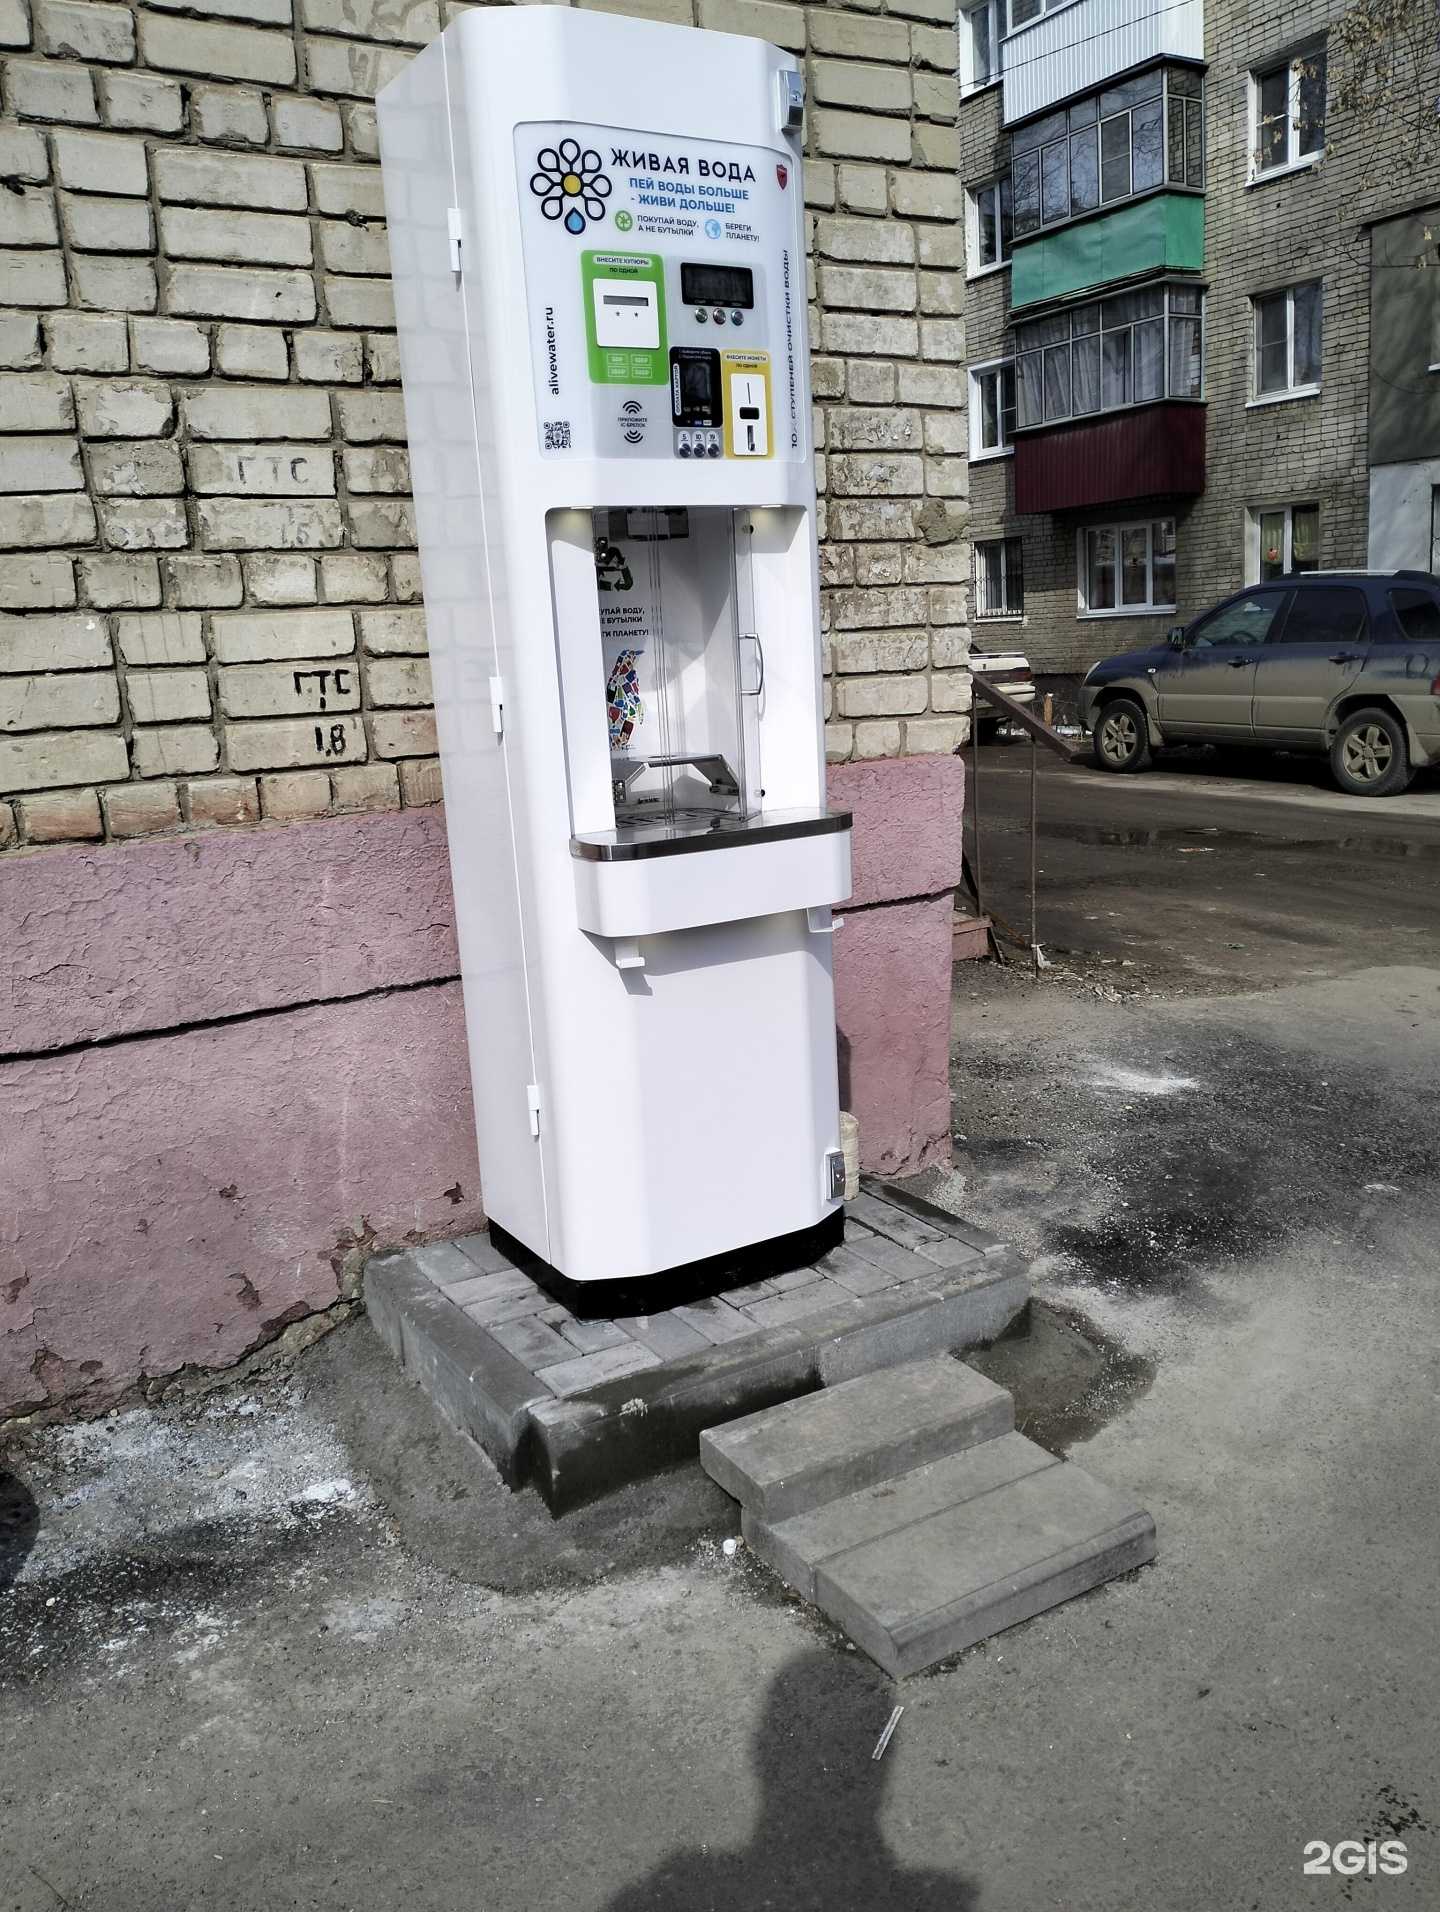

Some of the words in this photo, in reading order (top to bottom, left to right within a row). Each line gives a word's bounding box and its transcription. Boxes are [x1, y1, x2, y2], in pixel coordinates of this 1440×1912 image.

[610, 148, 690, 175] ЖИВАЯ
[698, 158, 757, 183] ВОДА
[629, 177, 655, 190] ПЕЙ
[657, 181, 695, 196] ВОДЫ
[698, 185, 750, 200] БОЛЬШЕ
[638, 194, 676, 208] ЖИВИ
[679, 199, 736, 214] ДОЛЬШЕ!
[637, 214, 675, 223] ПОКУПАЙ
[676, 218, 699, 229] ВОДУ,
[725, 222, 752, 232] БЕРЕГИ
[645, 225, 656, 233] НЕ
[657, 226, 695, 237] БУТЫЛКИ
[726, 231, 760, 243] ПЛАНЕТУ!
[785, 291, 794, 352] ОЧИСТКИ
[545, 307, 560, 395] alivewater.ru
[600, 607, 621, 615] УПАЙ
[622, 607, 645, 615] ВОДУ,
[607, 616, 643, 624] БУТЫЛКИ
[612, 629, 649, 637] ПЛАНЕТУ!
[293, 668, 350, 702] ГТС
